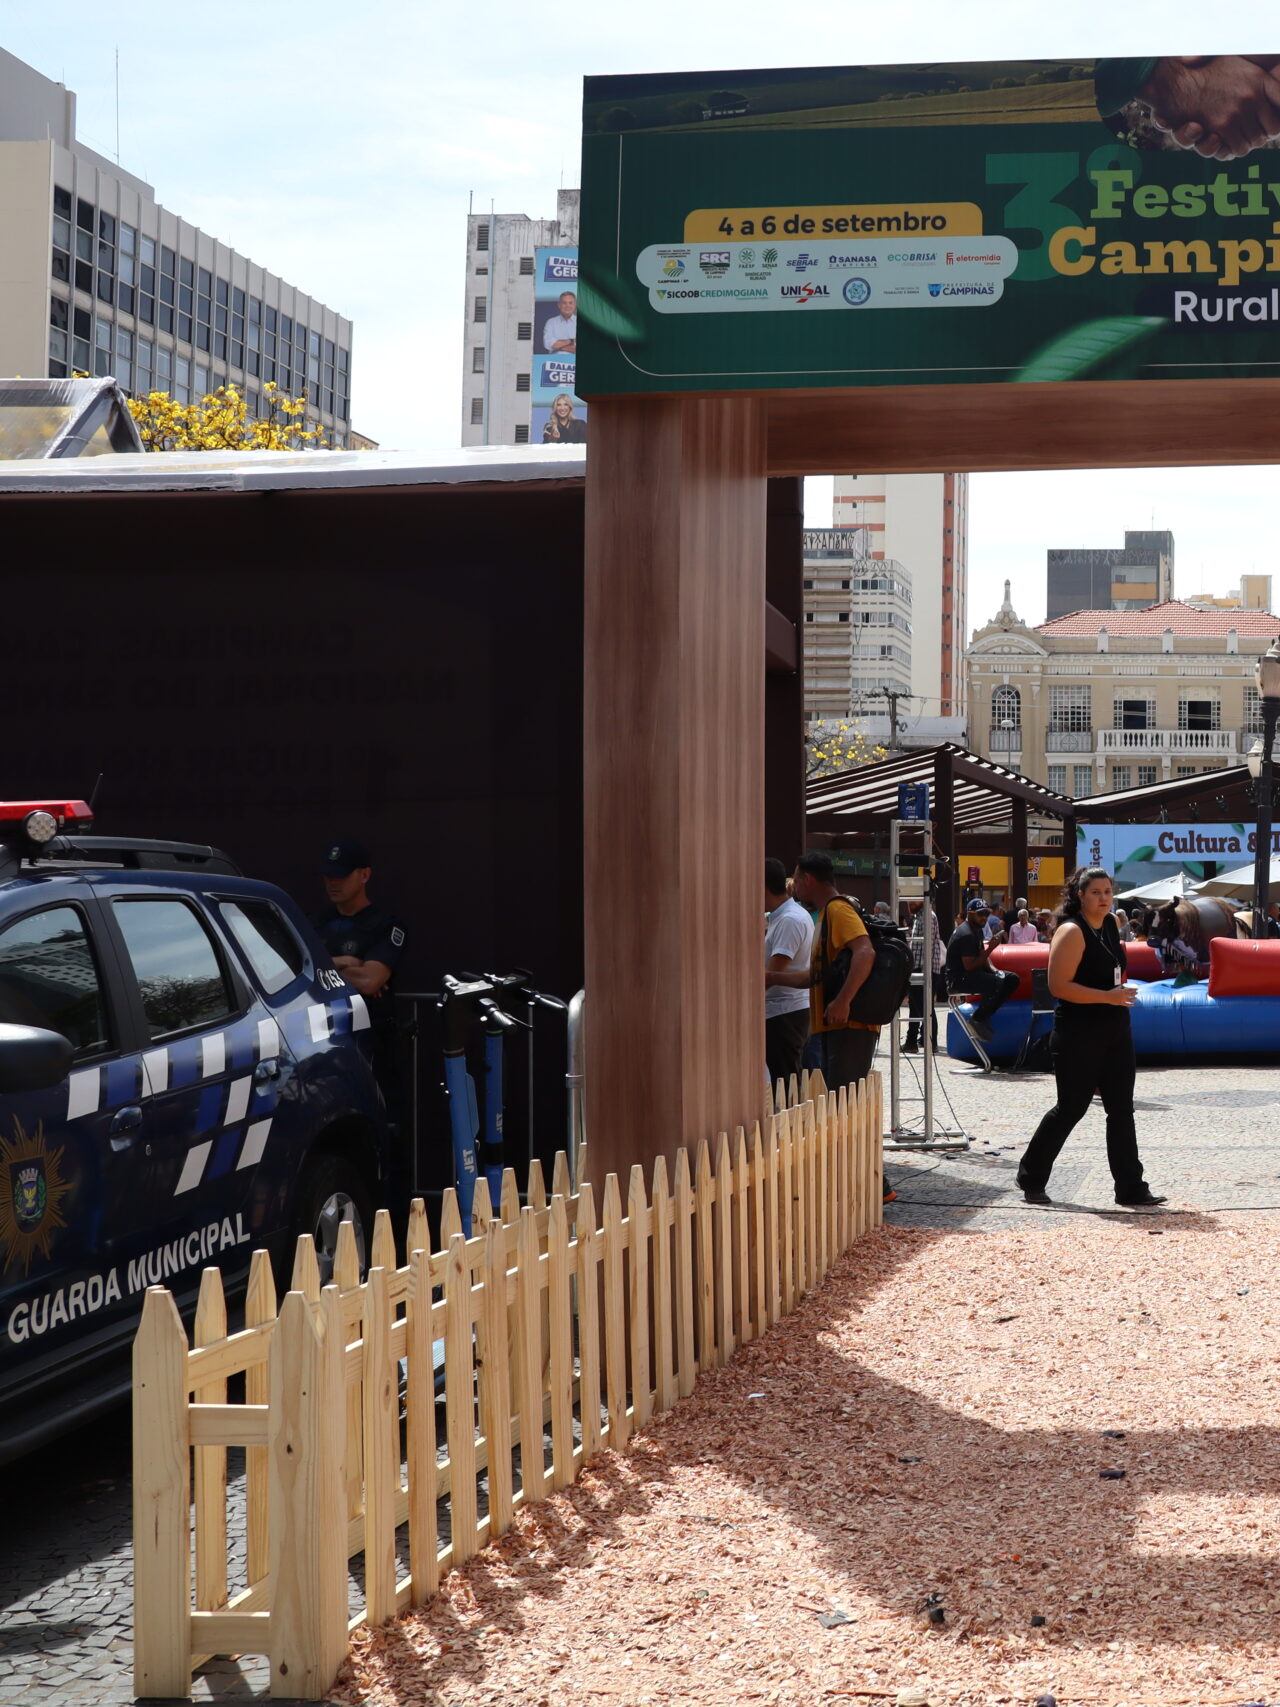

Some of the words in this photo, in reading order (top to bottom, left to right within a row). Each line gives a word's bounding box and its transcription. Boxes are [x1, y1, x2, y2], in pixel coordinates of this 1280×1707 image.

[718, 216, 734, 236] 4
[740, 220, 755, 236] a
[761, 215, 777, 235] 6
[783, 214, 816, 234] de
[822, 211, 947, 233] setembro
[553, 257, 578, 267] BALA
[700, 252, 730, 264] SRC
[786, 258, 819, 267] SEBRAE
[838, 255, 877, 263] SANASA
[887, 252, 937, 262] ecoBRISA
[552, 266, 578, 278] GER
[666, 289, 700, 299] SICOOB
[700, 288, 769, 298] CREDIMOGIANA
[781, 282, 830, 297] UNISAL
[942, 285, 994, 296] CAMPINAS
[1174, 288, 1280, 323] Rural
[549, 371, 575, 382] GER
[1158, 830, 1242, 854] Cultura
[325, 969, 346, 988] 153
[463, 1149, 474, 1174] JET
[7, 1267, 122, 1344] GUARDA
[127, 1212, 251, 1295] MUNICIPAL
